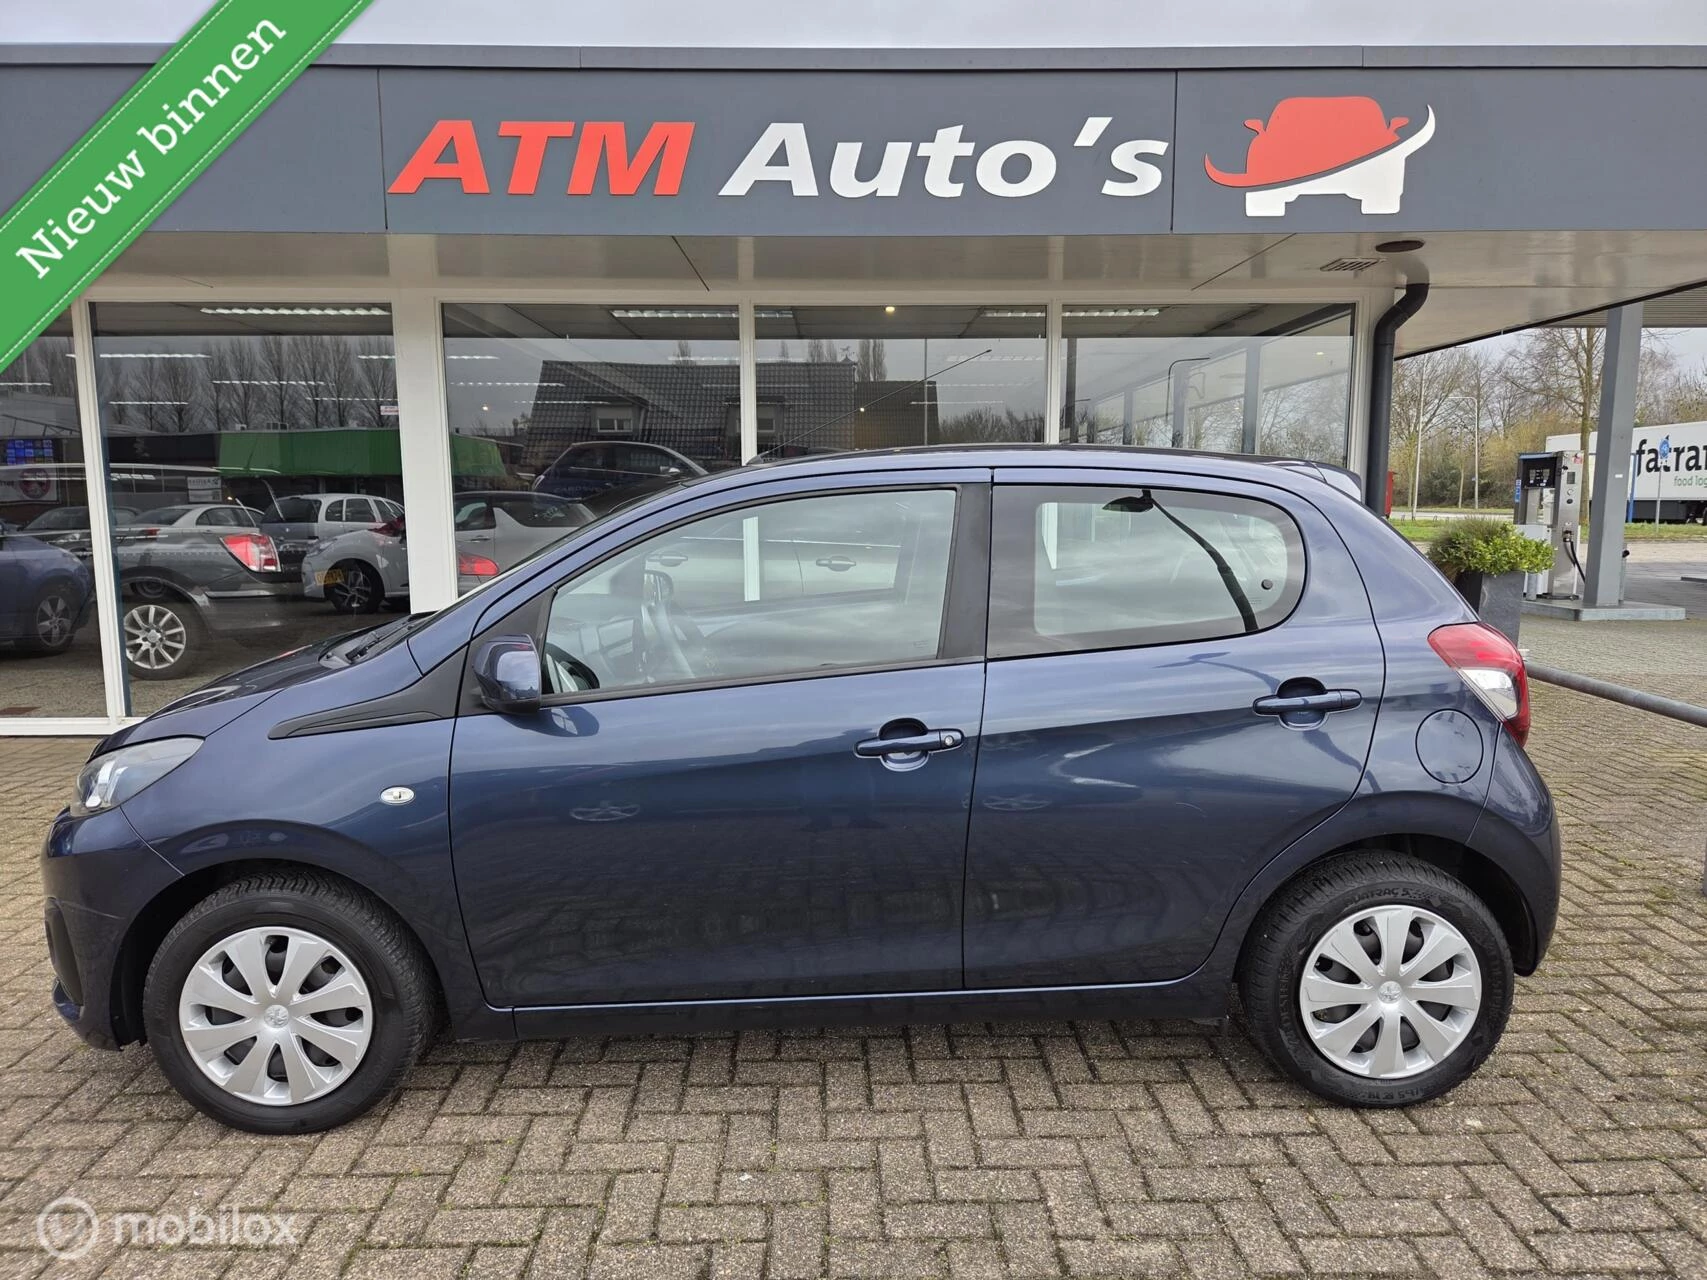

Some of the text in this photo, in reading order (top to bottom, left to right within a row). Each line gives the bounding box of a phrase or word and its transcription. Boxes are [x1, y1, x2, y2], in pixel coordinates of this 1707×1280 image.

[387, 116, 1170, 199] ATM Auto's
[1674, 475, 1693, 487] food
